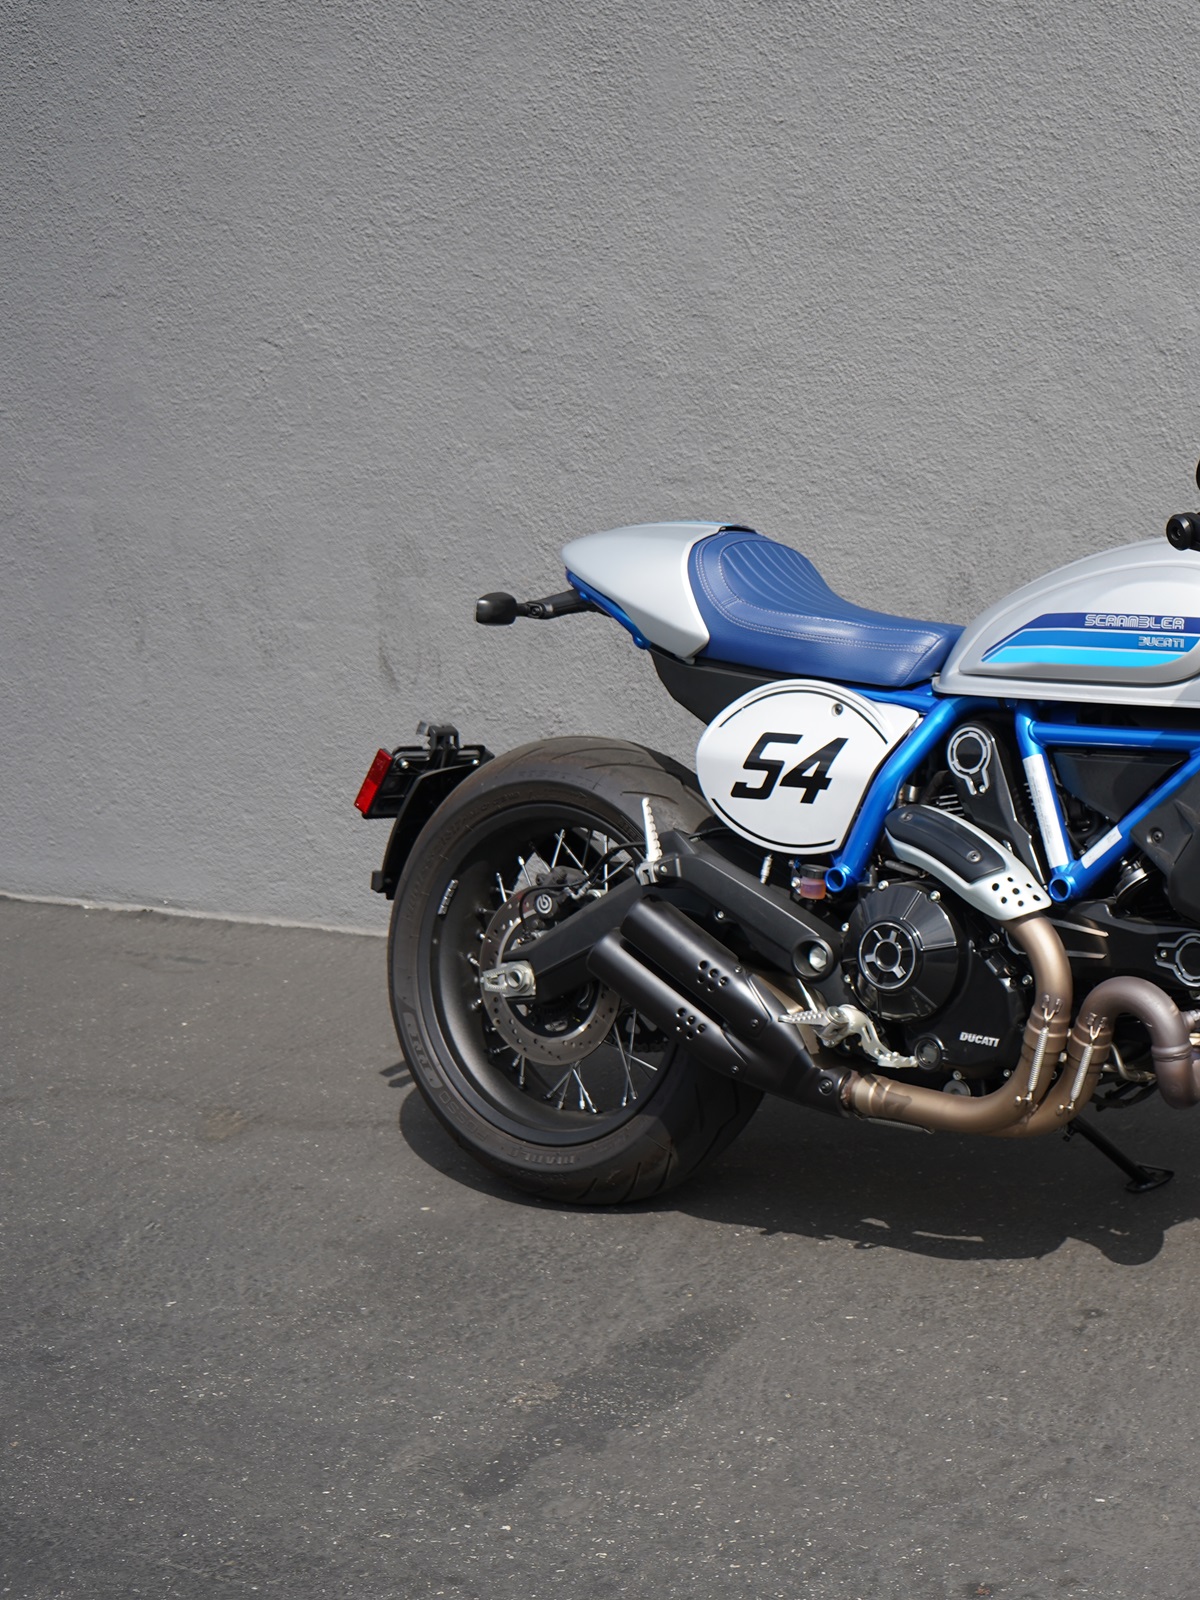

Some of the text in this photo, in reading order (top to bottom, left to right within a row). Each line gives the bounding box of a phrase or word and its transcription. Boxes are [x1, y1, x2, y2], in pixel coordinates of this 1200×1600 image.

[1083, 613, 1185, 630] SCRAMBLER
[1137, 635, 1185, 649] DUCATI
[731, 732, 849, 804] 54
[959, 1031, 1000, 1047] DUCATI
[440, 1091, 488, 1141] ROSSO
